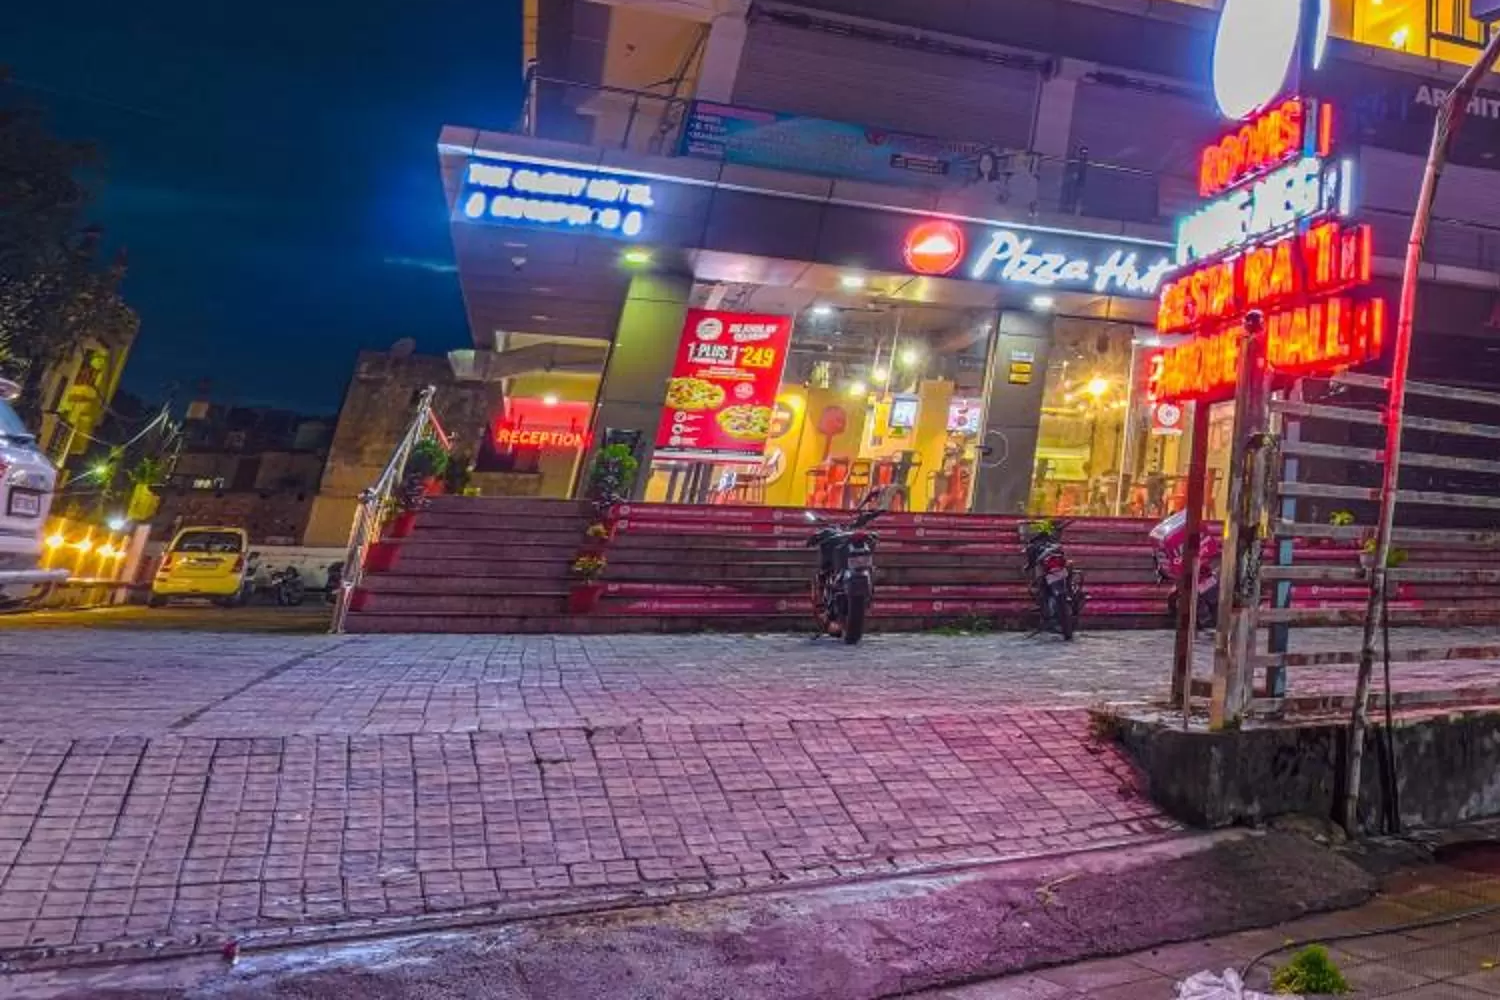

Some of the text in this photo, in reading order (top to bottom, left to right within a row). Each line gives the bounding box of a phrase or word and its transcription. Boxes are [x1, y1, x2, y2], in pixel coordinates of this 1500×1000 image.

[1200, 98, 1302, 197] ROOMS
[971, 229, 1178, 293] Pizza Hut
[697, 343, 729, 359] PLUS
[1267, 297, 1351, 369] HALL
[496, 428, 585, 447] RECEPTION
